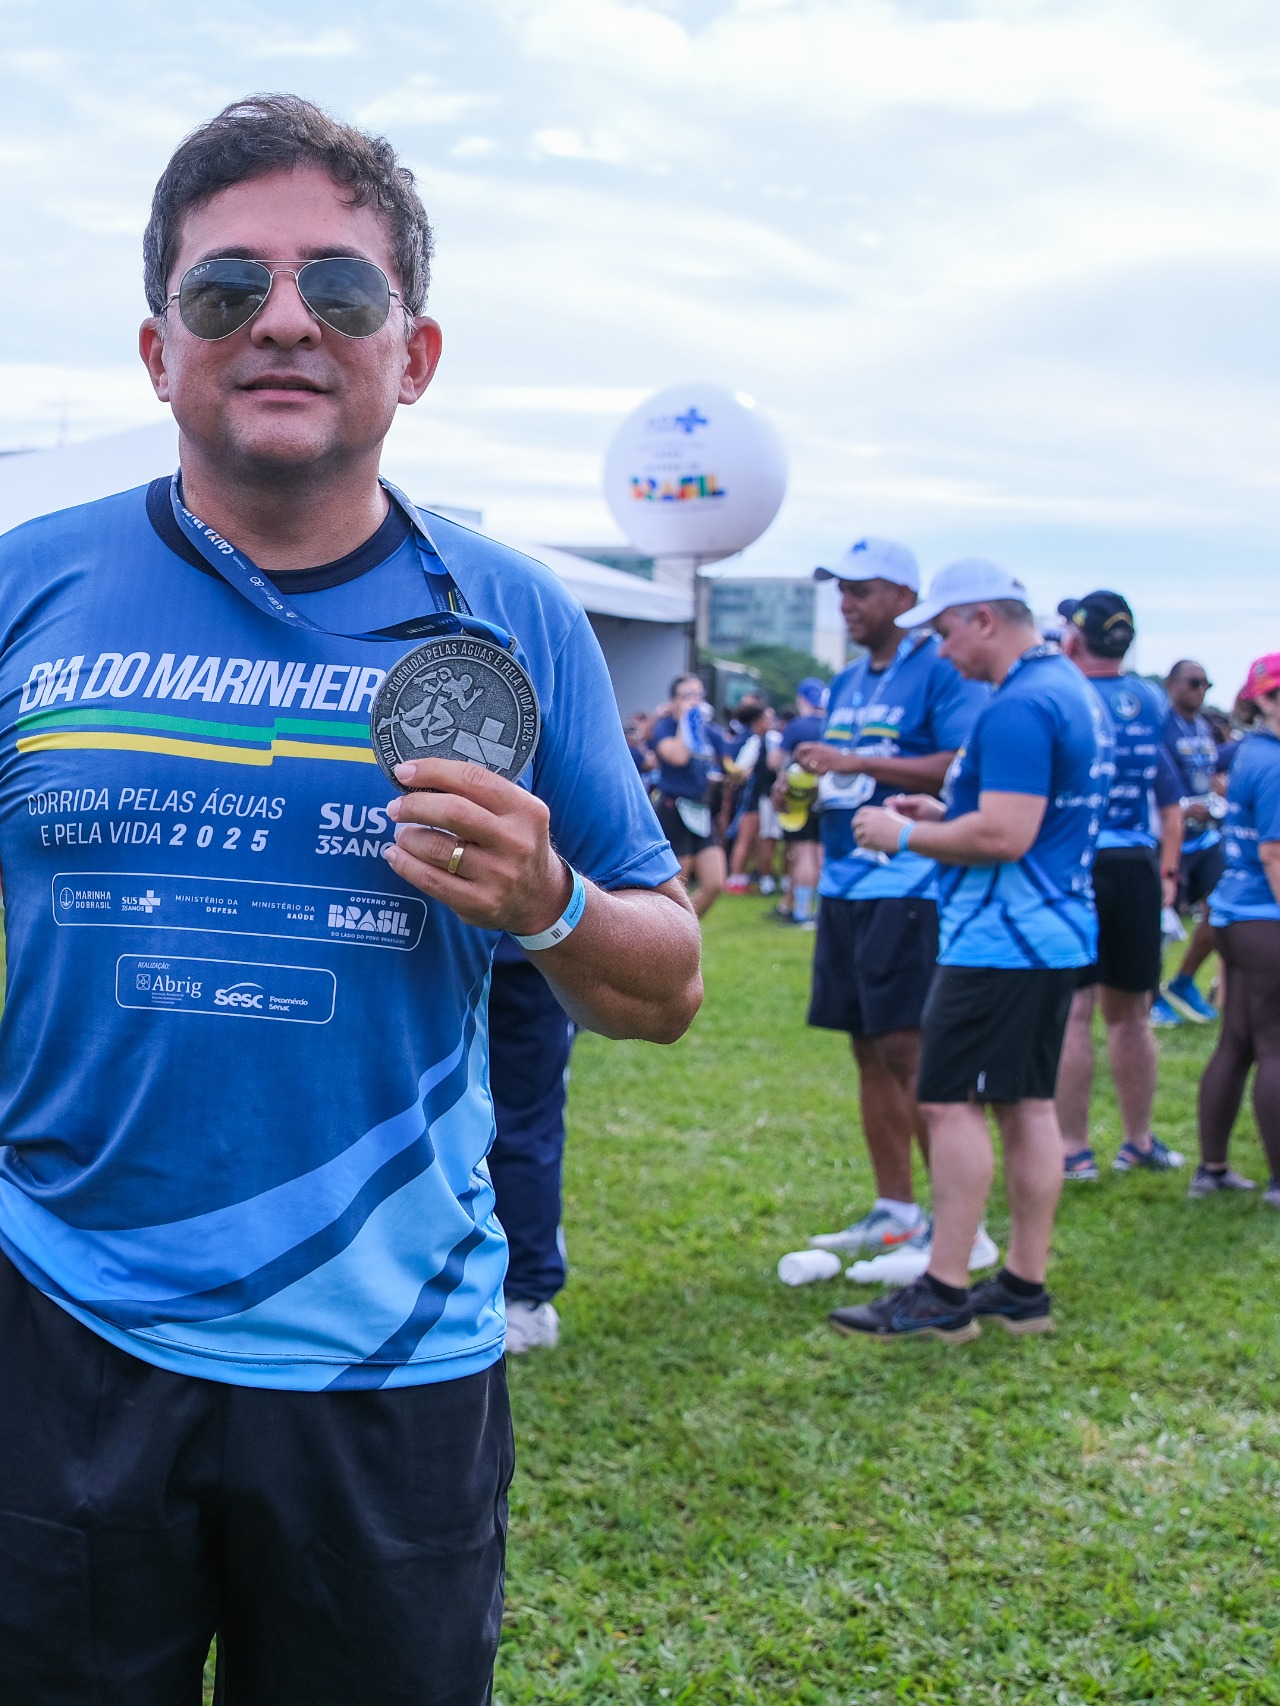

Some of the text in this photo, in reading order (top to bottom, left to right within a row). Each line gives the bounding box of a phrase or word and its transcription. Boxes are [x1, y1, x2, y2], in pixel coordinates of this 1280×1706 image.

[426, 643, 457, 661] PELAS
[461, 642, 494, 662] ÁGUAS
[389, 654, 425, 692] CORRIDA
[500, 661, 523, 687] PELA
[19, 652, 386, 714] DIA DO MARINHEIR
[517, 685, 533, 711] VIDA
[522, 714, 535, 742] 2025
[380, 734, 392, 751] DIA
[383, 750, 396, 765] DO
[27, 787, 286, 820] CORRIDA PELAS ÁGUAS
[318, 802, 388, 834] SUS
[40, 824, 50, 847] E
[54, 822, 102, 846] PELA
[109, 821, 162, 845] VIDA
[75, 890, 111, 900] MARINHA
[121, 896, 138, 905] SUS
[175, 894, 239, 906] MINISTÉRIO DA
[349, 896, 387, 906] GOVERNO
[206, 906, 238, 915] DEFESA
[251, 901, 301, 911] MINISTÉRIO
[286, 912, 315, 921] SAÚDE
[327, 904, 411, 937] BRASIL
[152, 975, 203, 999] Abrig
[269, 1004, 290, 1012] Senac
